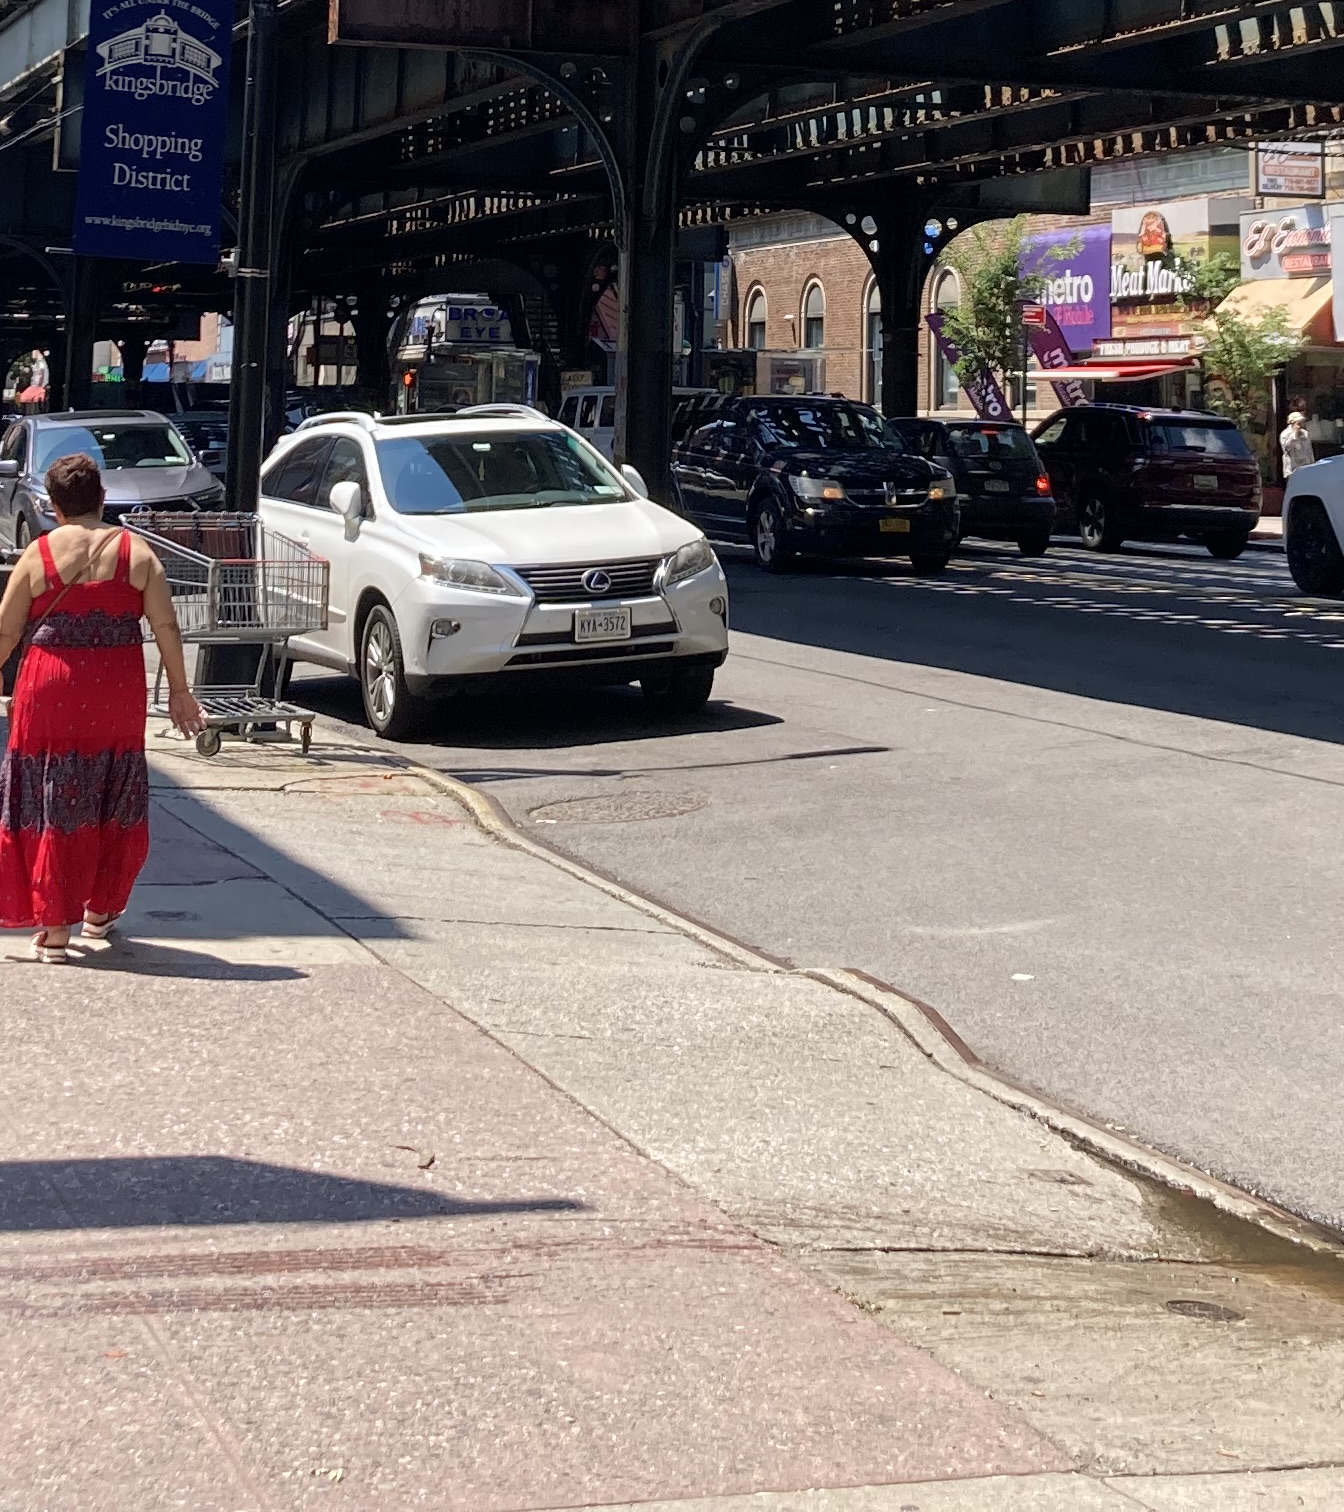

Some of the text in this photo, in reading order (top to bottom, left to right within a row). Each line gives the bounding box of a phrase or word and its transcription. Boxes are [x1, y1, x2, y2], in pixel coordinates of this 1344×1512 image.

[104, 68, 214, 105] kingsbridge
[103, 124, 203, 162] Shopping
[113, 162, 191, 192] District
[1109, 264, 1145, 297] Meat
[460, 326, 501, 338] EYE
